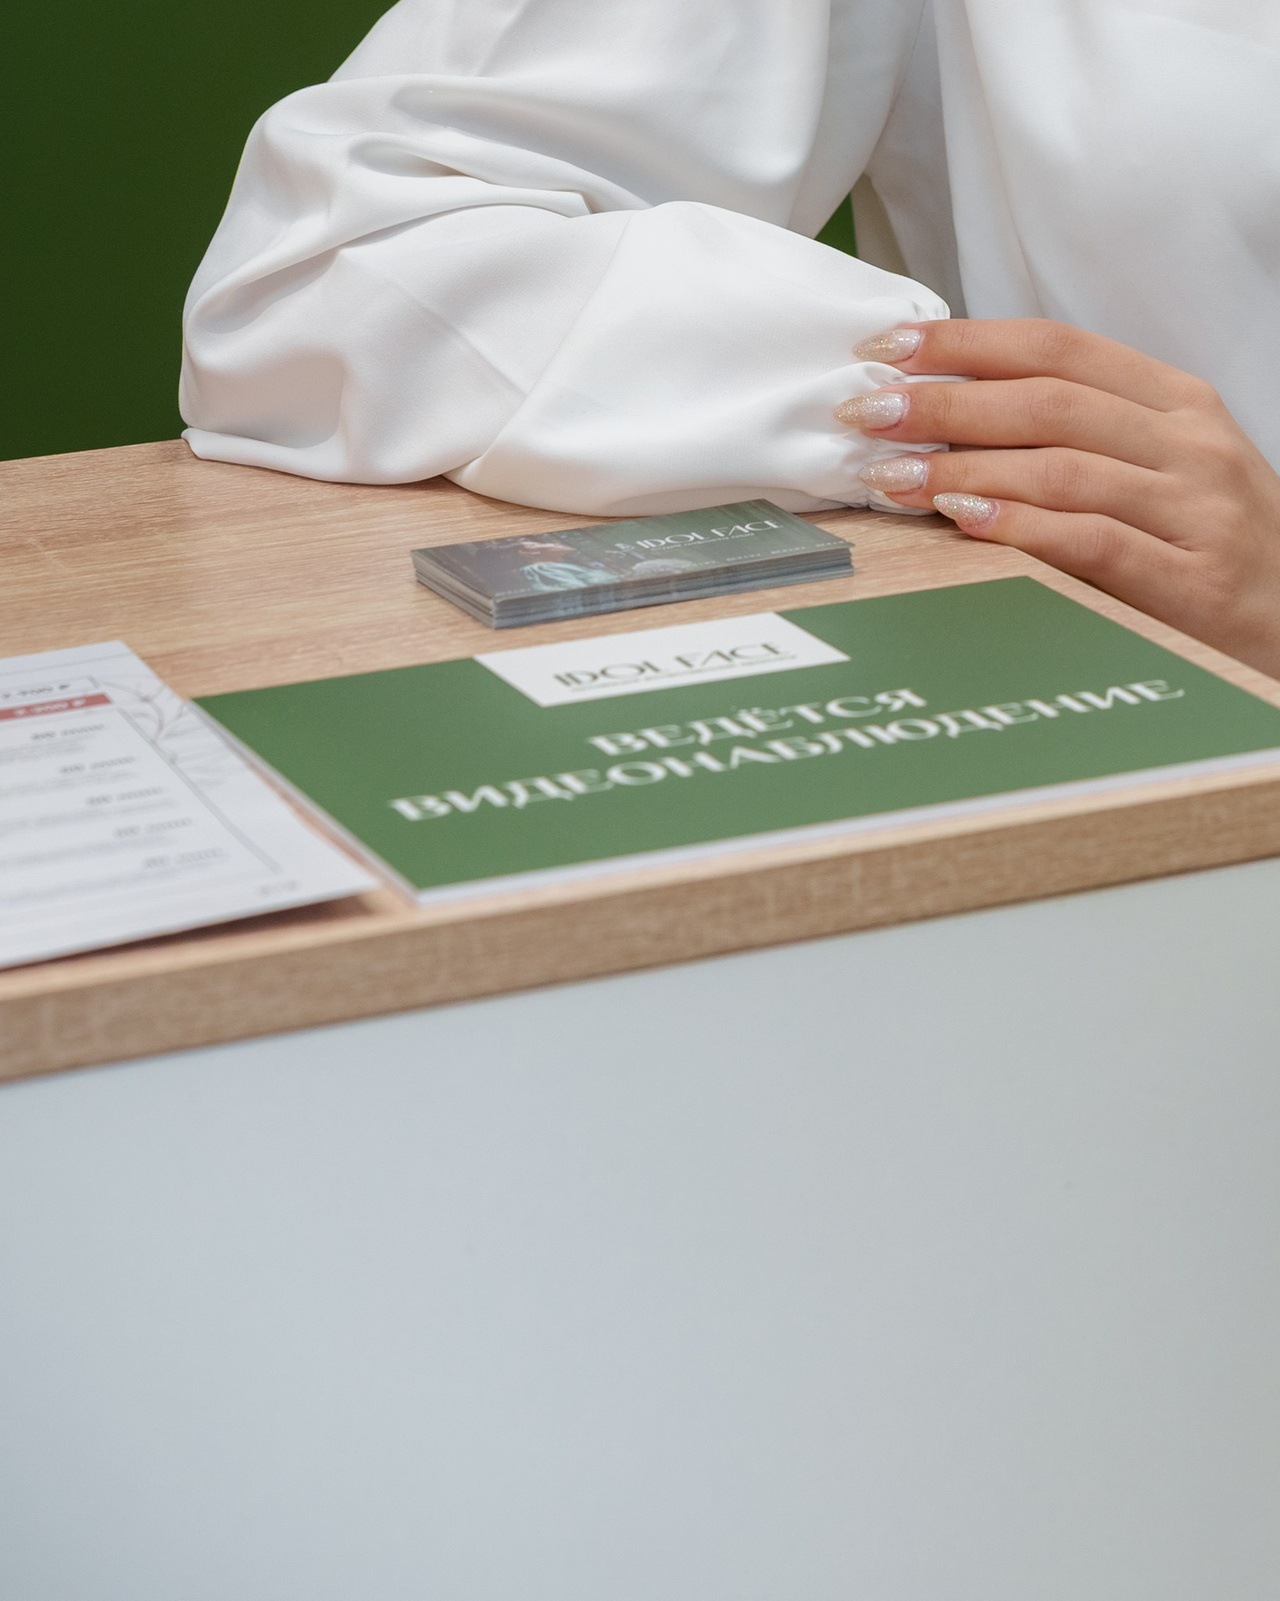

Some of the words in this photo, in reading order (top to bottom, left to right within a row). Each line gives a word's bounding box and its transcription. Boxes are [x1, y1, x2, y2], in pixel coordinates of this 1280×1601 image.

[636, 531, 710, 549] IDOL
[711, 519, 783, 538] FACE
[552, 660, 668, 687] IDOL
[674, 641, 788, 669] FACE
[391, 678, 1185, 822] ВИДЕОНАБЛЮДЕНИЕ
[589, 687, 927, 756] ВЕДЁТСЯ
